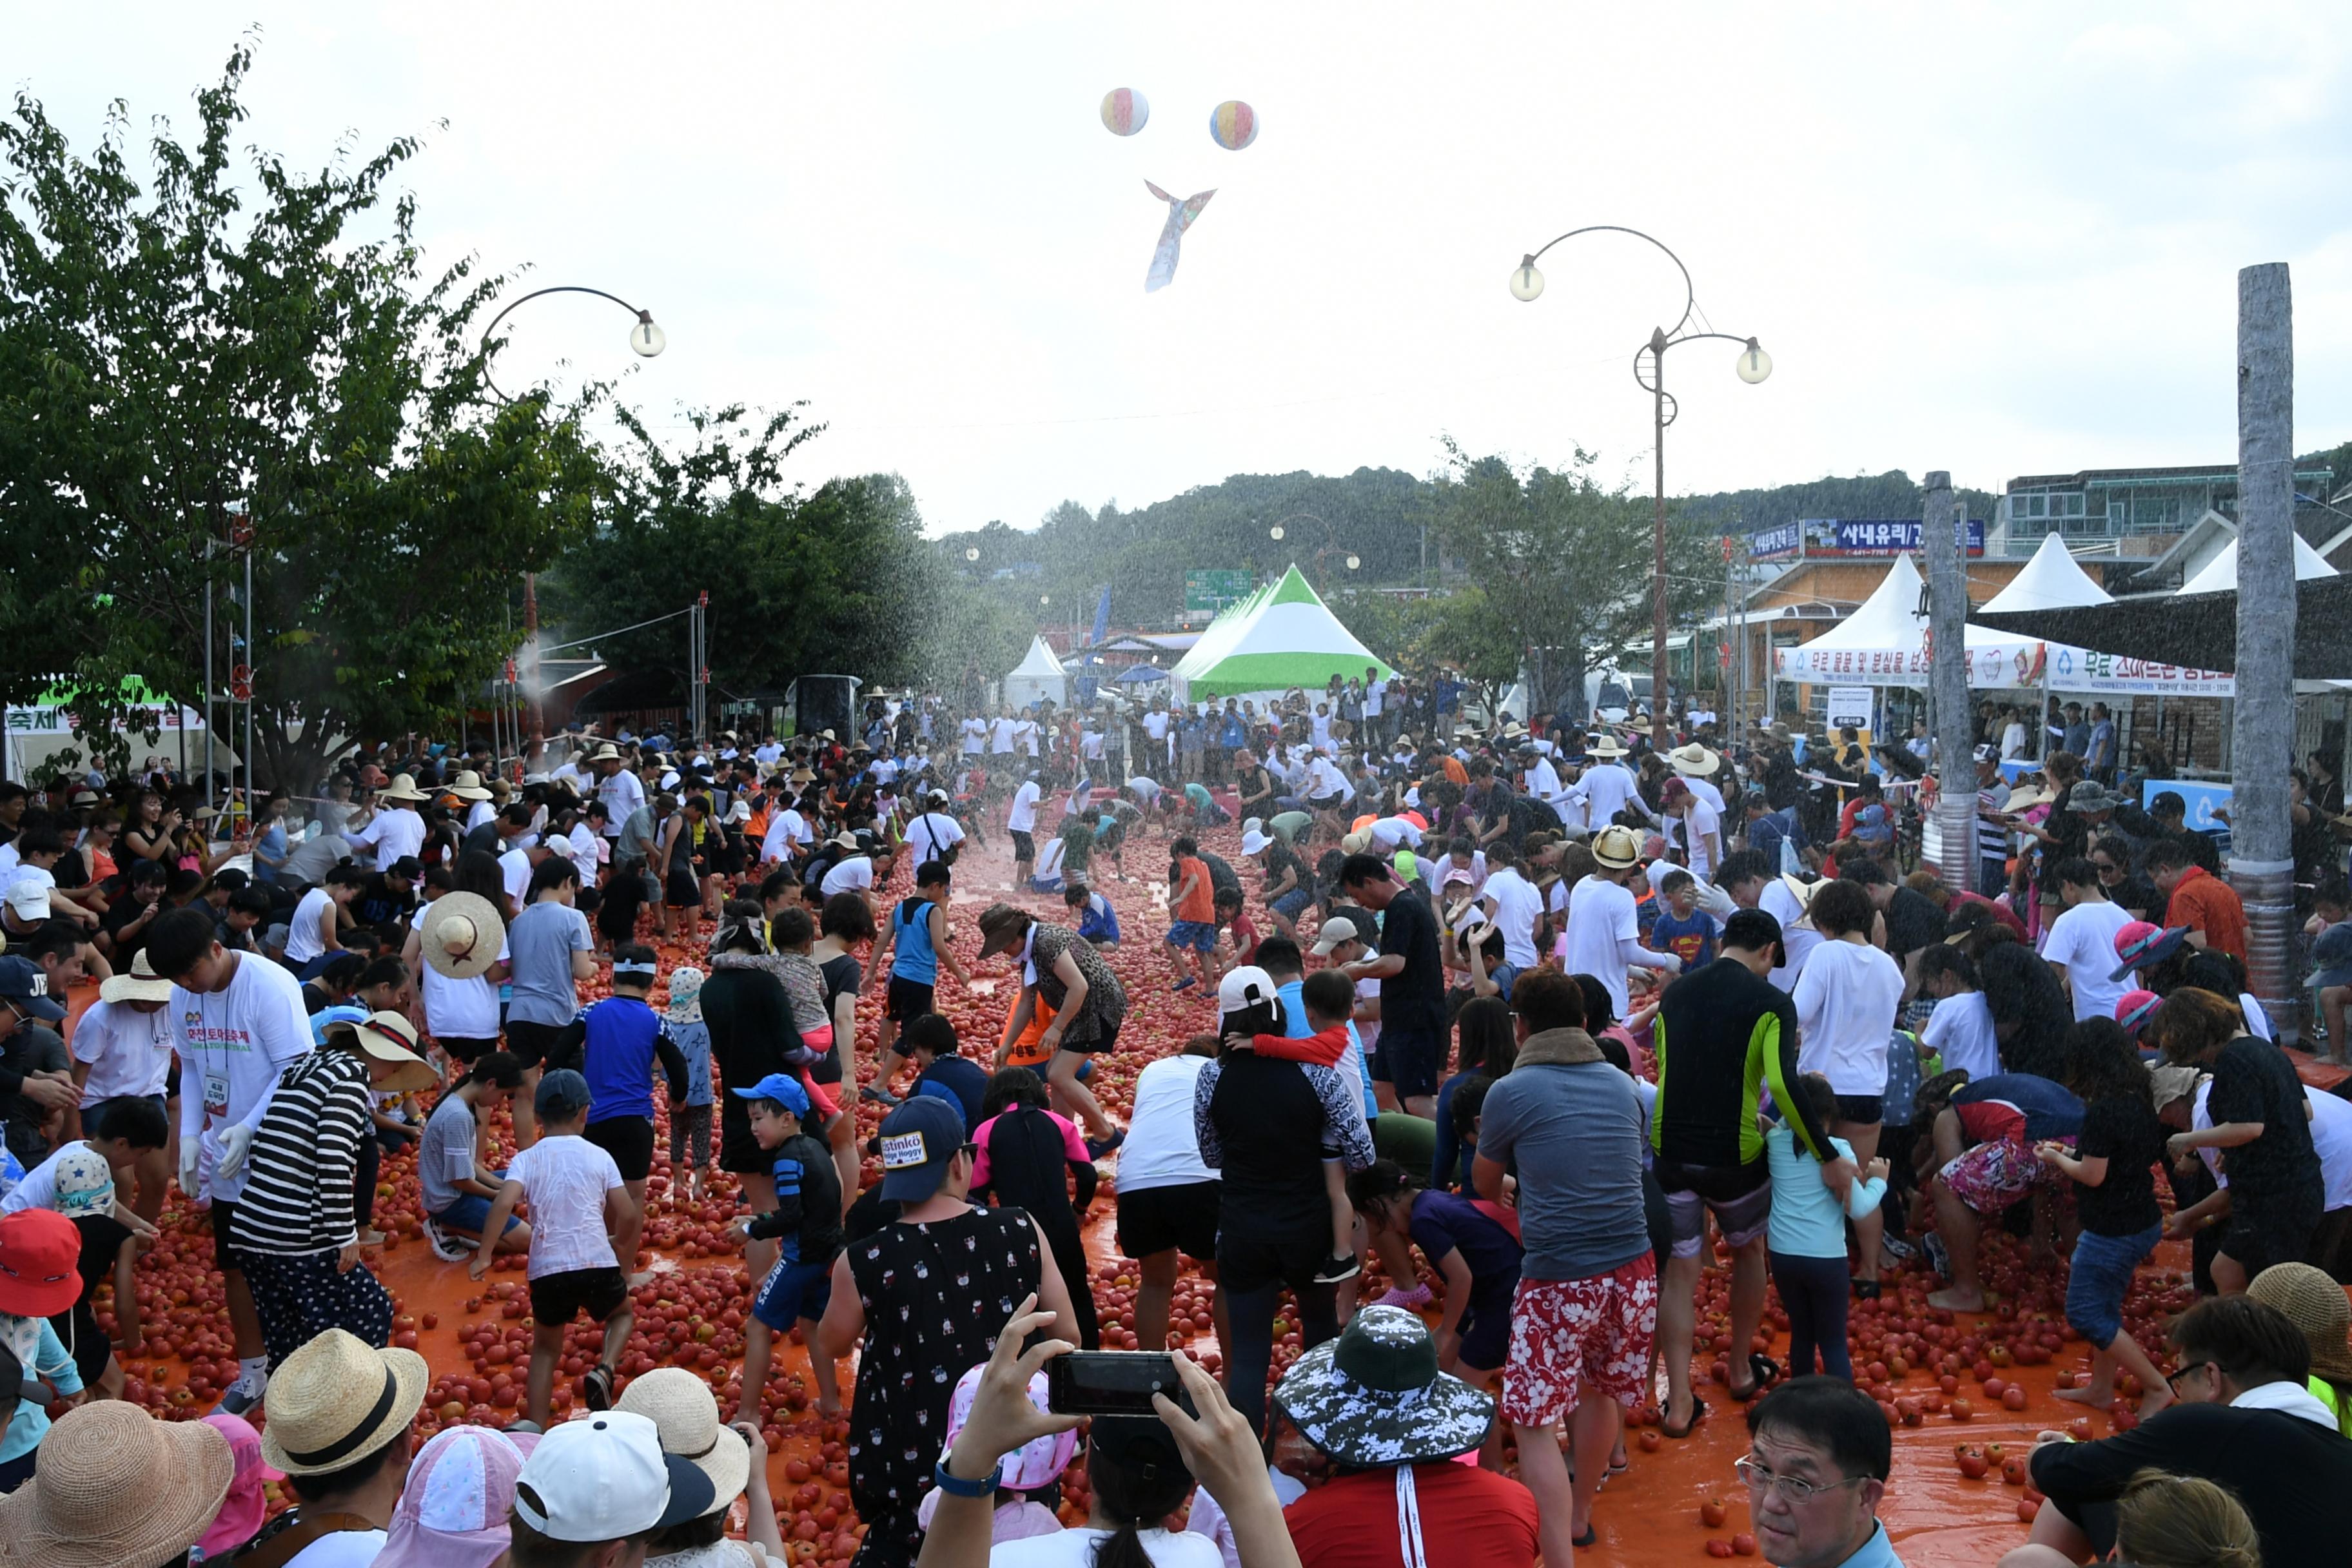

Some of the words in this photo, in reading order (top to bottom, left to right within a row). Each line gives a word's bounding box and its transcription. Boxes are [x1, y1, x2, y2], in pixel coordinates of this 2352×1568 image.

[1811, 651, 1829, 672] 무료
[1833, 652, 1852, 673] 물품
[1857, 652, 1867, 674] 및
[1872, 652, 1904, 674] 분실물
[2084, 651, 2112, 678] 무료
[8, 710, 57, 730] 축제
[898, 1148, 921, 1158] Hoggy
